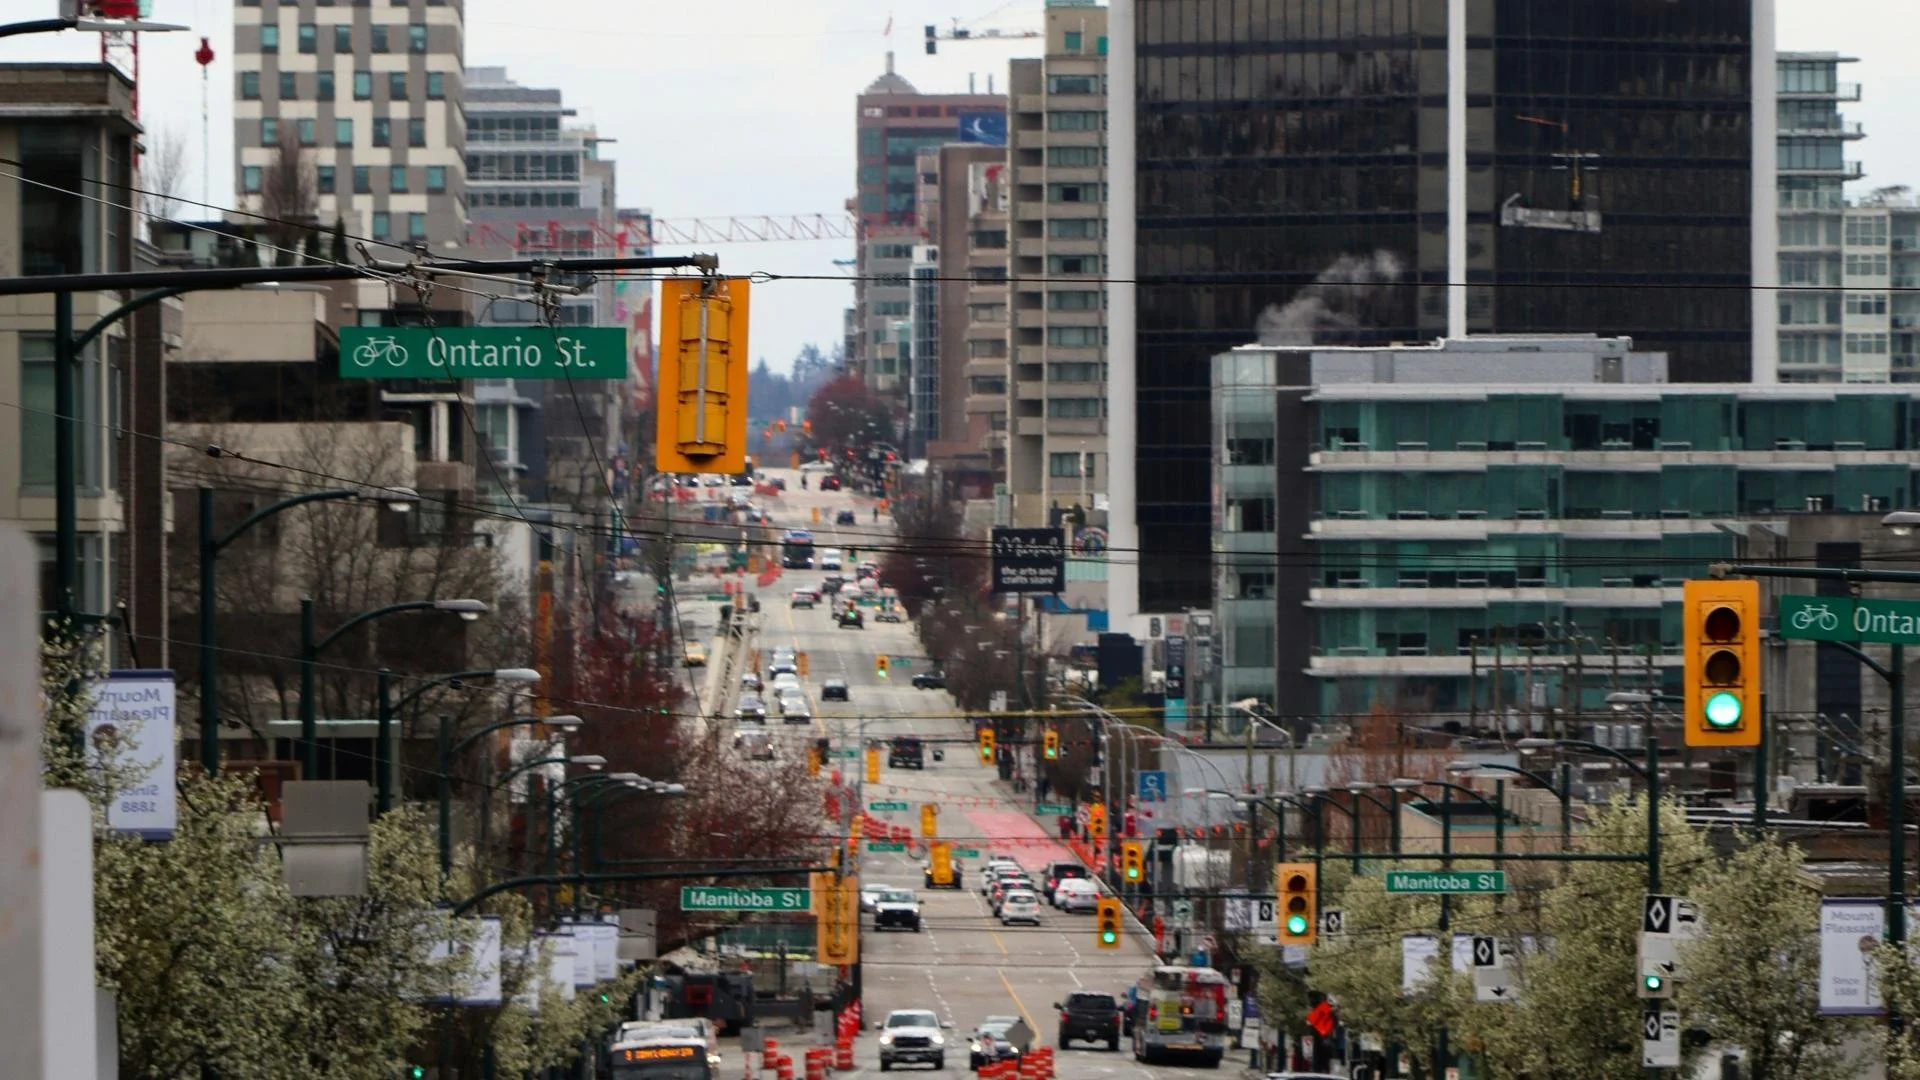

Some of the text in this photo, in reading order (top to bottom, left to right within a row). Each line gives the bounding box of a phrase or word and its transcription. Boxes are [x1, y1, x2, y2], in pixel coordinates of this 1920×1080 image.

[427, 336, 597, 367] Ontario St.
[1394, 875, 1496, 890] Manitoba St
[691, 891, 801, 907] Manitoba St
[1831, 911, 1875, 921] Mount
[1825, 923, 1880, 934] Pleasant
[1832, 976, 1860, 985] Since
